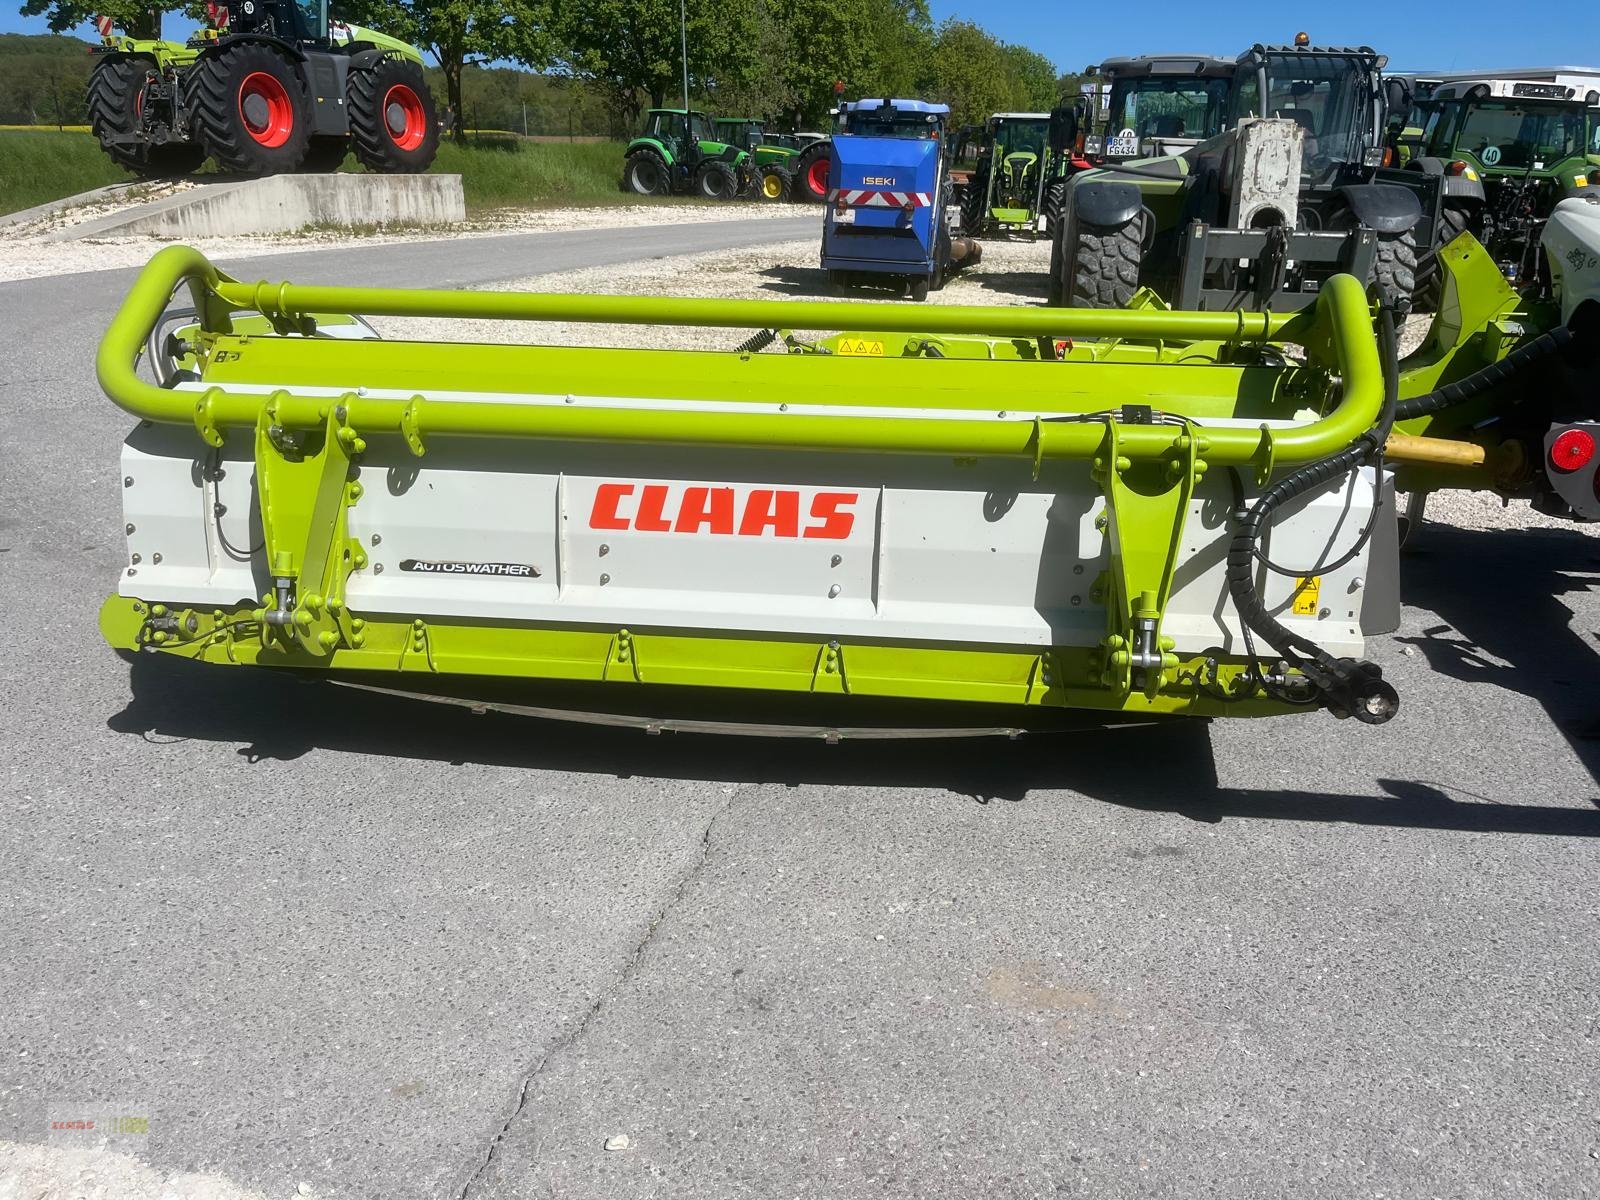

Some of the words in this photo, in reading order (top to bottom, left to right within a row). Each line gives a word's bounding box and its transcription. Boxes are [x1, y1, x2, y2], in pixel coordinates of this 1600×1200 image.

[1113, 138, 1124, 146] BC
[1485, 149, 1498, 162] 40
[863, 176, 896, 186] ISEKI
[589, 483, 859, 540] CLAAS
[412, 561, 530, 576] AUTOSWATHER
